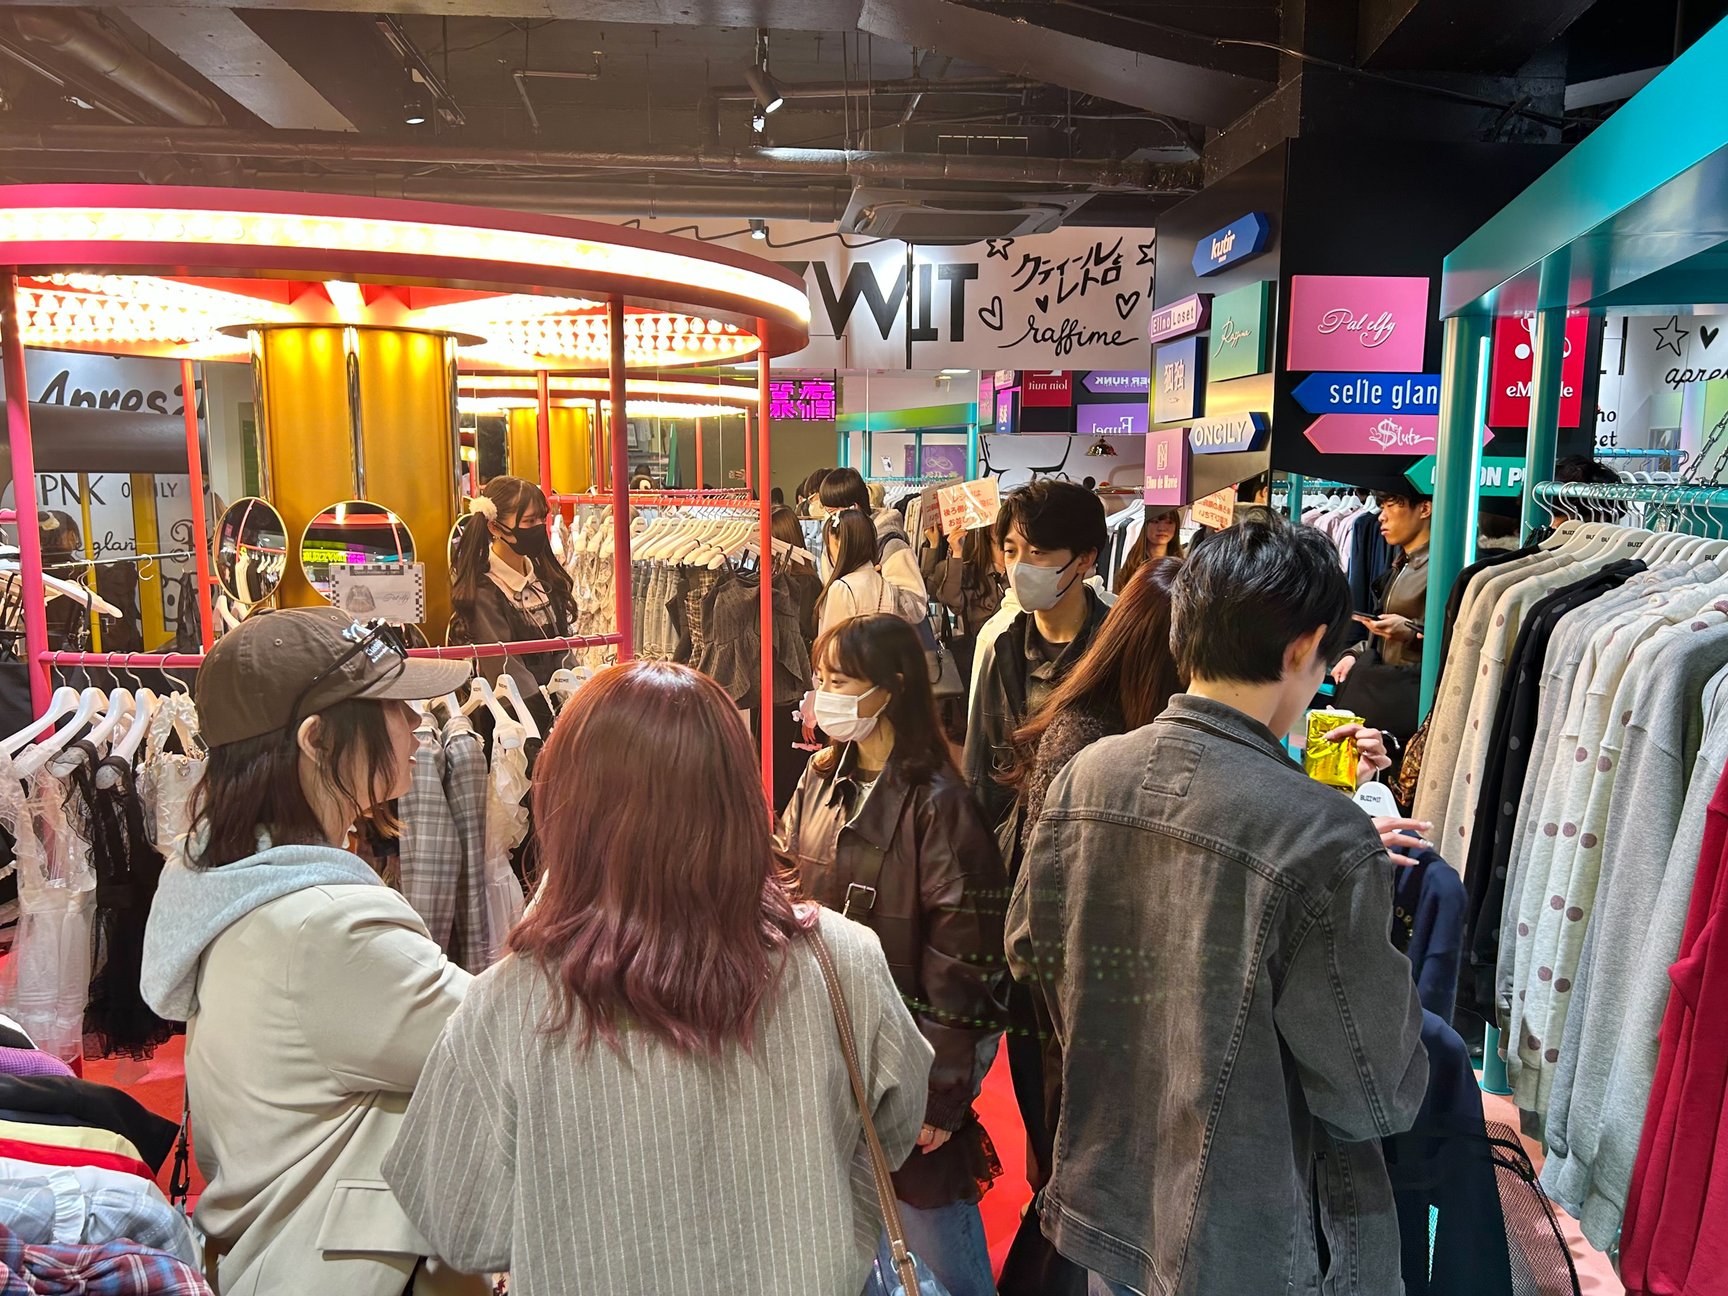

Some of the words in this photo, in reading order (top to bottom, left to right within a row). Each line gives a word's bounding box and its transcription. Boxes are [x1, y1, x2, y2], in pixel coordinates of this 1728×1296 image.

[1210, 229, 1236, 260] kutir
[997, 314, 1139, 356] raffime
[1317, 308, 1368, 334] Pal
[1163, 358, 1185, 393] 孤独
[1194, 421, 1248, 447] ONCILY
